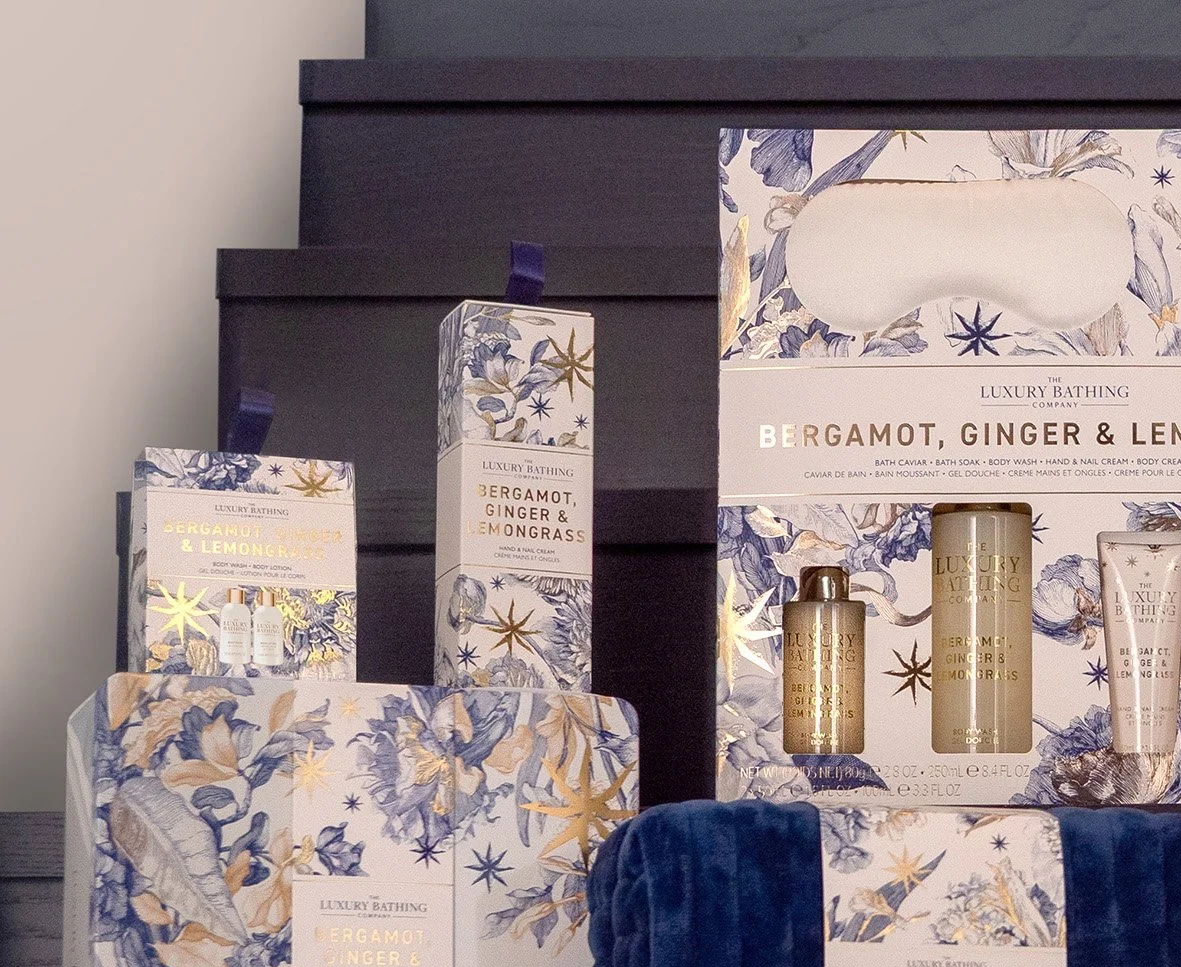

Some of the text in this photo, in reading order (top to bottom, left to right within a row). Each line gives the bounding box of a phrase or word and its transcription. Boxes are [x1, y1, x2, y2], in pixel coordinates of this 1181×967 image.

[980, 385, 1130, 399] LUXURY BATHING
[758, 423, 944, 450] BERGAMOT,
[960, 423, 1080, 447] GINGER
[1095, 423, 1115, 447] &
[935, 458, 956, 466] BATH
[958, 458, 980, 466] SOAK
[988, 458, 1011, 466] BODY
[1012, 458, 1037, 466] WASH
[1045, 458, 1070, 466] HAND
[482, 461, 575, 477] LUXURY BATHING
[803, 470, 832, 479] CAVIAR
[834, 470, 845, 479] DE
[847, 470, 867, 479] BAIN
[874, 470, 894, 479] BAIN
[895, 470, 940, 479] MOUSSANT
[947, 470, 962, 478] GEL
[964, 470, 999, 478] DOUCHE
[1035, 470, 1060, 478] MAINS
[1062, 470, 1071, 478] ET
[1074, 470, 1106, 478] ONGLES
[1141, 470, 1164, 478] POUR
[1165, 470, 1174, 478] LE
[477, 484, 578, 507] BERGAMOT,
[214, 505, 289, 516] LUXURY BATHING
[485, 503, 569, 523] GINGER &
[466, 522, 586, 544] LEMONGRASS
[535, 547, 556, 555] CREAM
[1014, 764, 1030, 777] OZ
[945, 784, 962, 796] OZ
[319, 900, 428, 913] LUXURY BATHING
